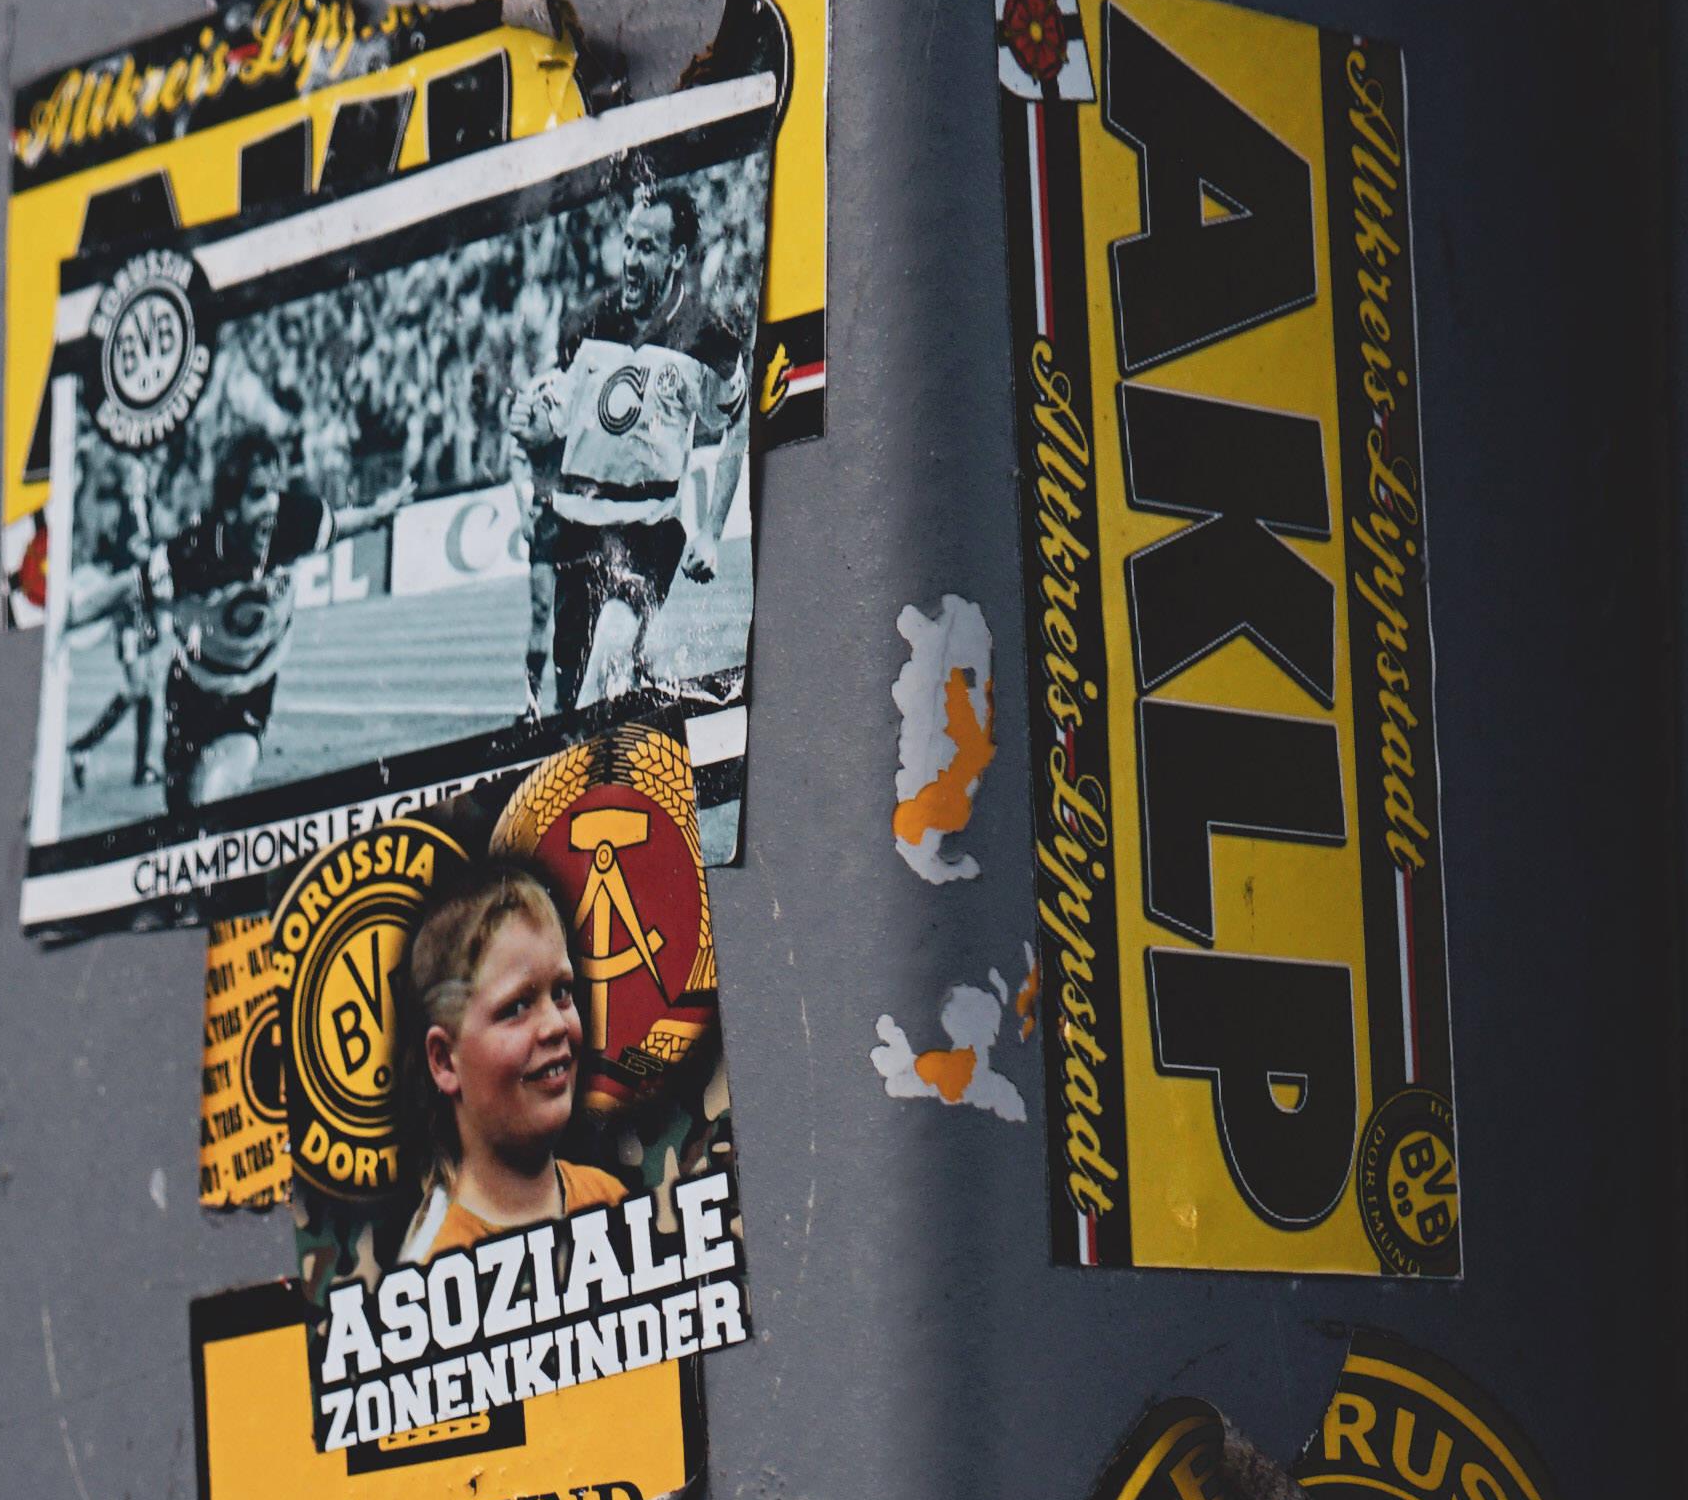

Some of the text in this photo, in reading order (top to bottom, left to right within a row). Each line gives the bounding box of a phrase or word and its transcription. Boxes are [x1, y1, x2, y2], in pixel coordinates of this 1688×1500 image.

[1347, 41, 1433, 873] Altkreis Lippstadt
[133, 819, 319, 897] CHAMPIONS
[1031, 338, 1119, 1214] Altkreis Lippstadt
[270, 833, 436, 990] BORUSSIA
[300, 1117, 398, 1187] DORT
[320, 1172, 737, 1384] ASOZIALE
[320, 1280, 747, 1453] ZONENKINDER
